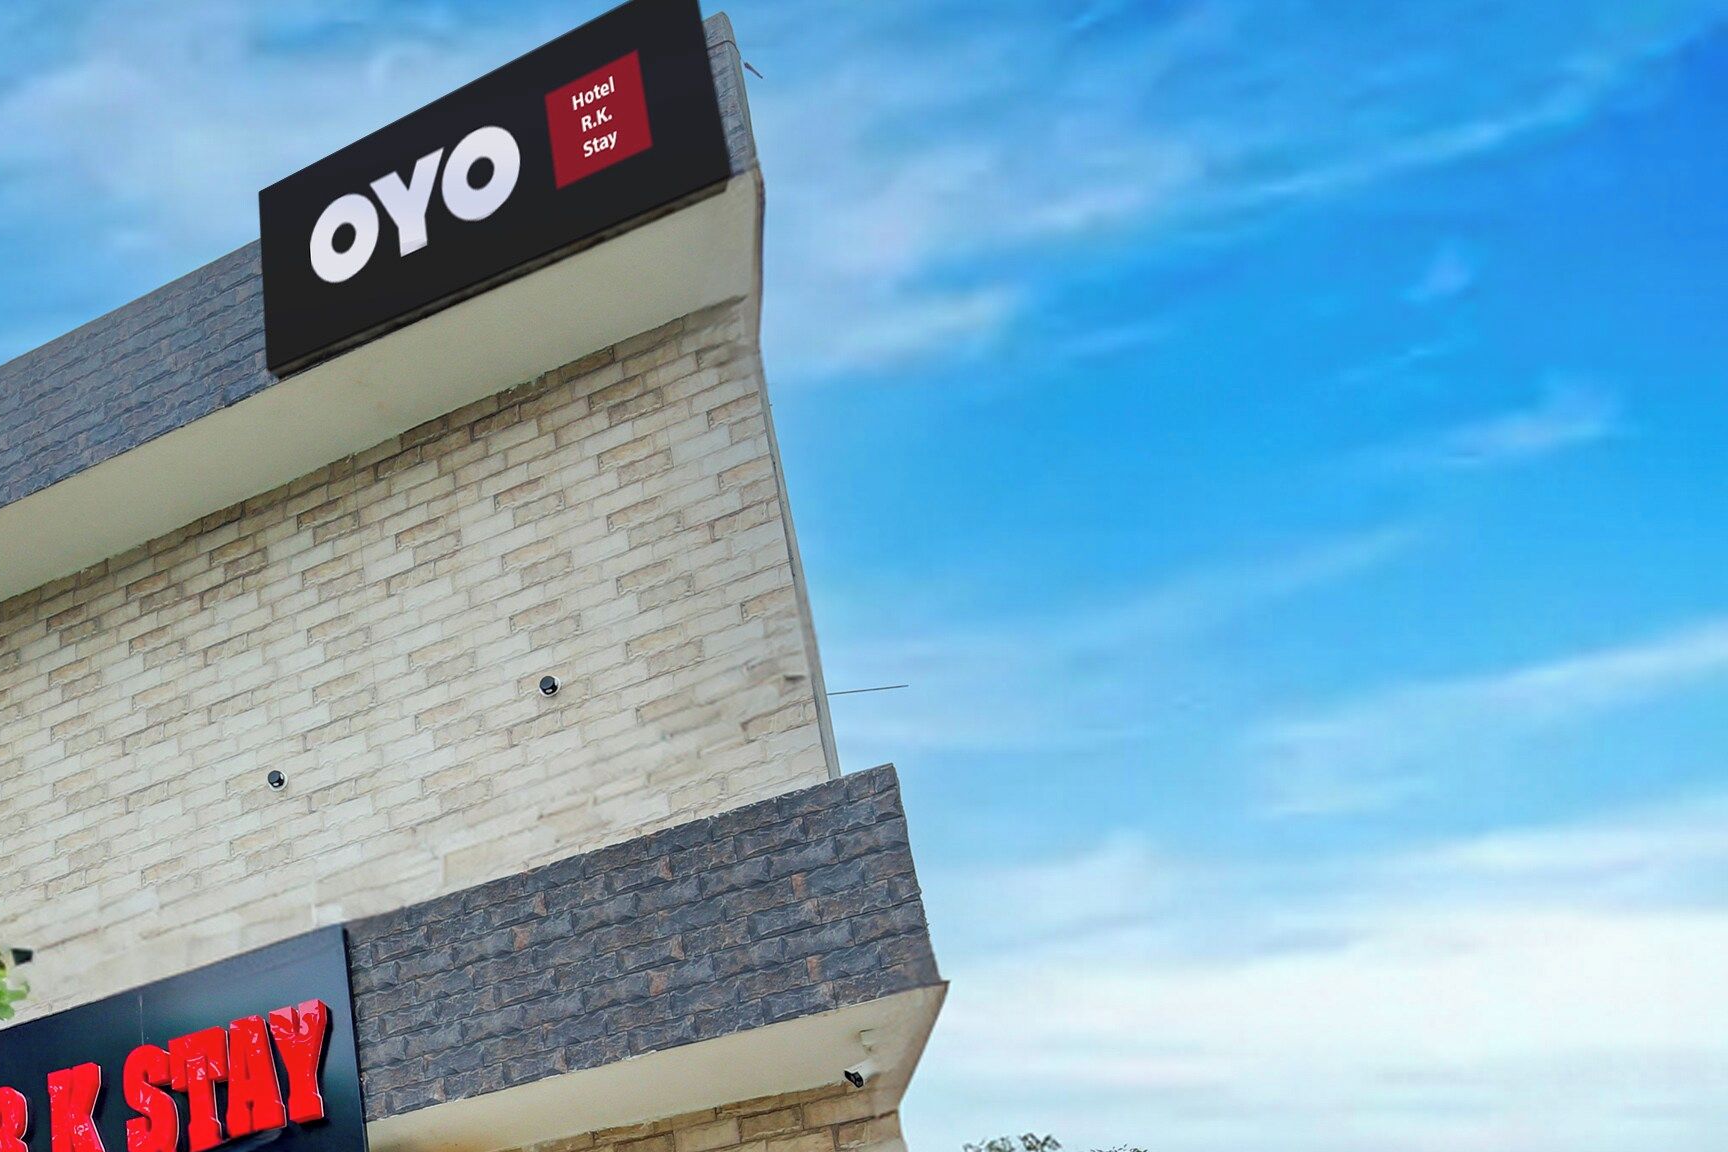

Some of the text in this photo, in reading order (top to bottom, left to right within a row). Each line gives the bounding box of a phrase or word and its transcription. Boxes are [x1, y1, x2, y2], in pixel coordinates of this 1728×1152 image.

[572, 75, 615, 111] Hotel
[581, 106, 613, 132] R.K.
[583, 131, 617, 158] Stay
[310, 126, 520, 283] OYO
